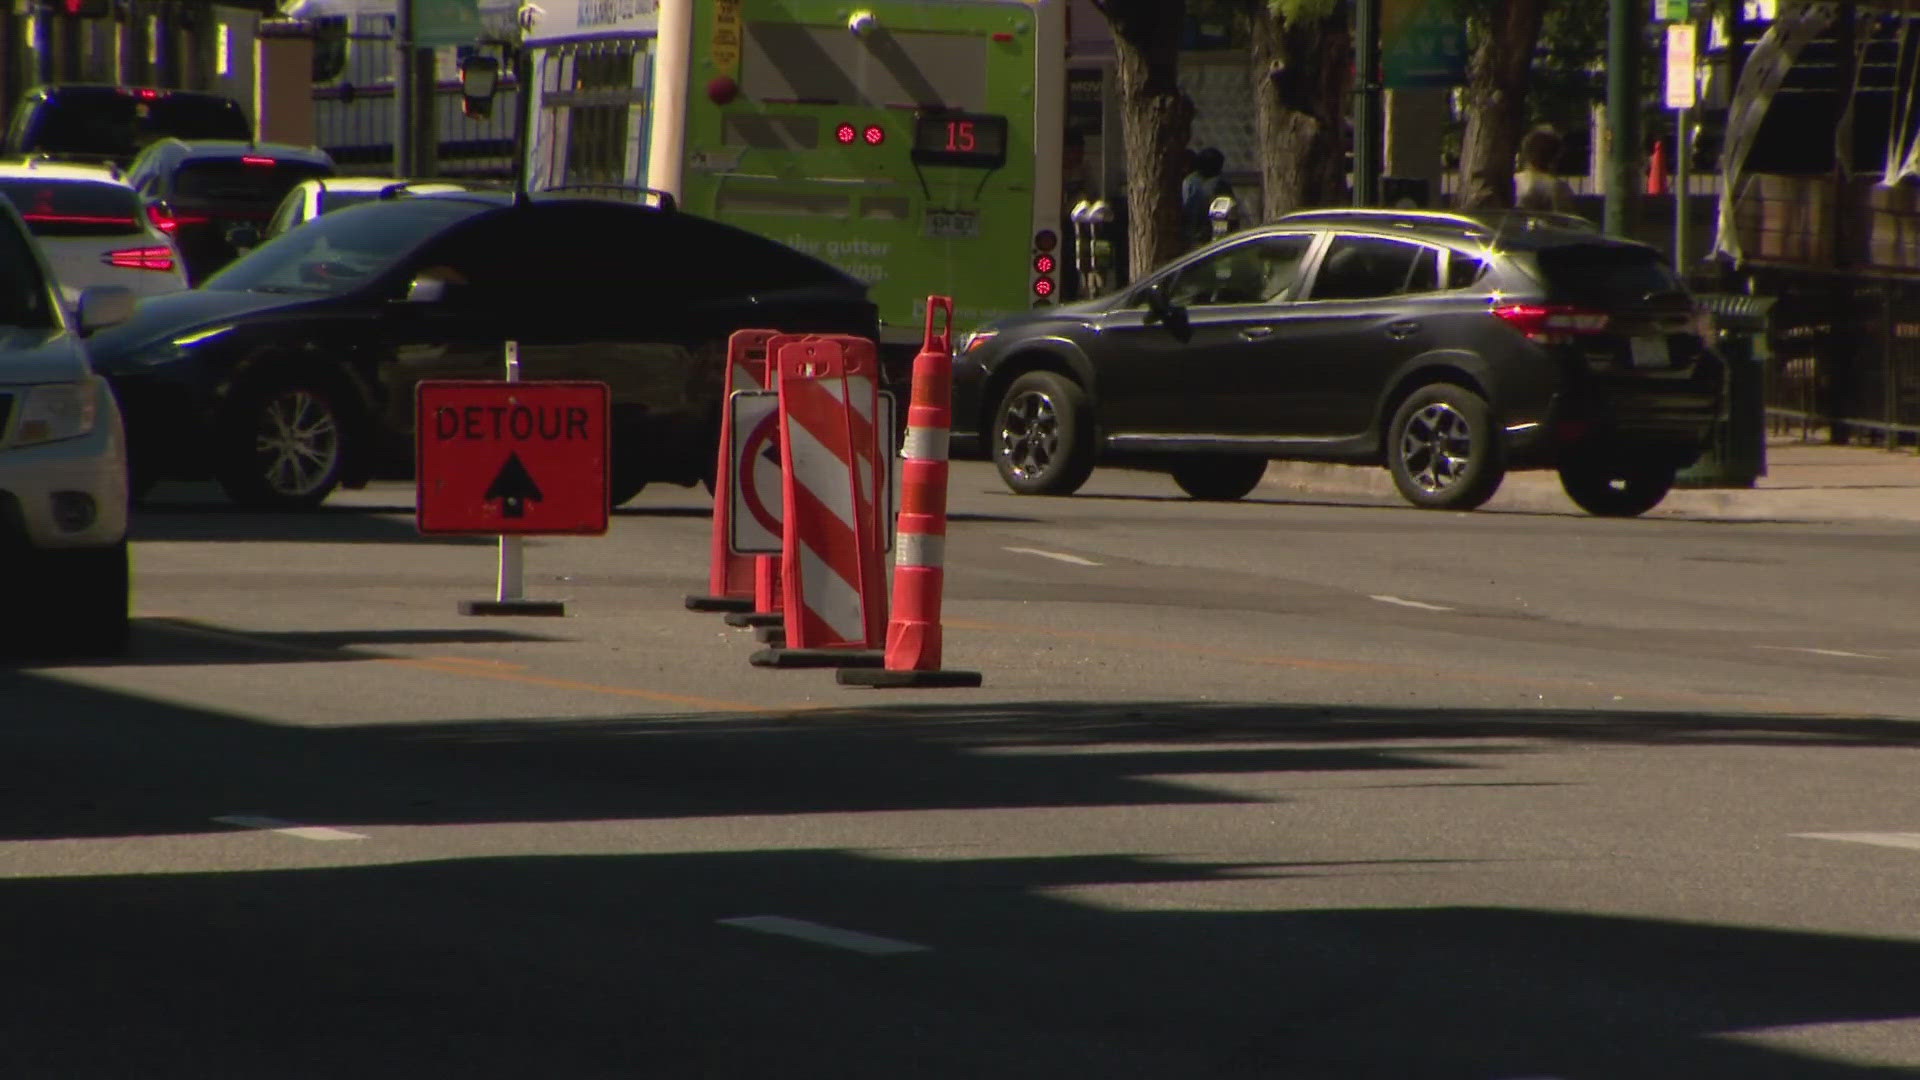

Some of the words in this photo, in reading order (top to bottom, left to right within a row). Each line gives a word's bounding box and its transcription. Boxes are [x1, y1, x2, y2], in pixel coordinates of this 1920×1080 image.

[945, 121, 976, 151] 15
[826, 236, 892, 259] gutter
[435, 405, 590, 440] DETOUR
